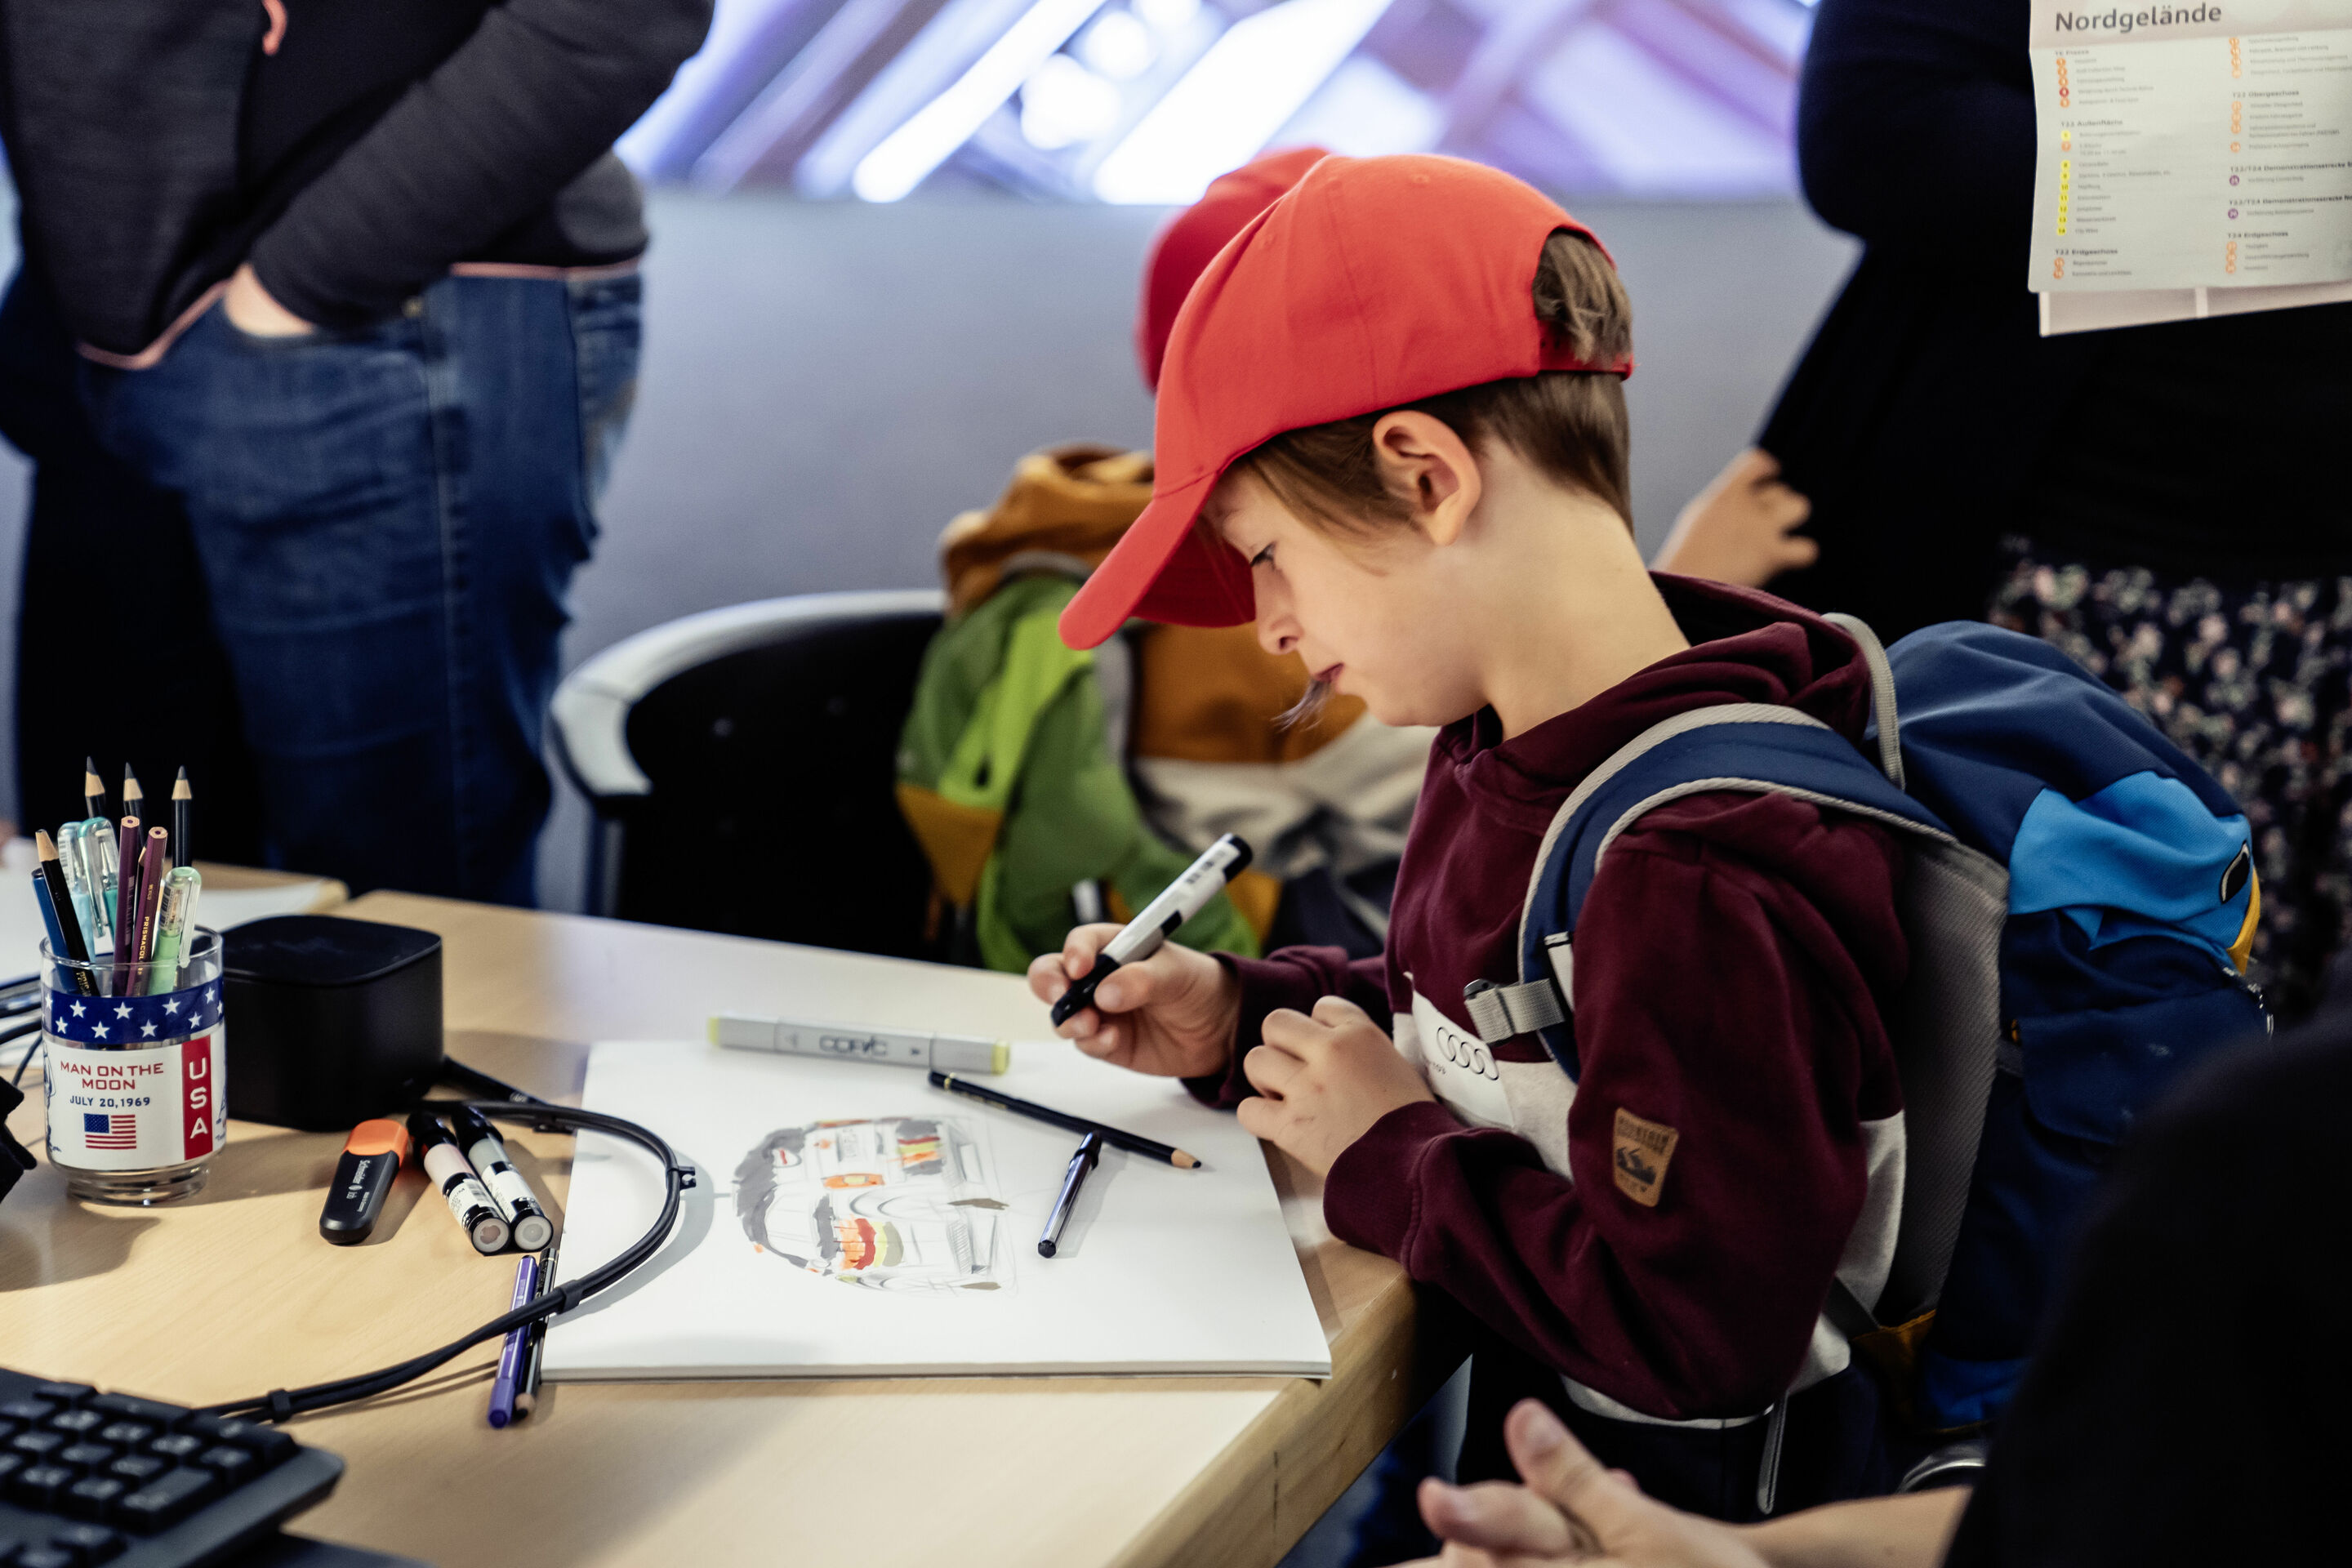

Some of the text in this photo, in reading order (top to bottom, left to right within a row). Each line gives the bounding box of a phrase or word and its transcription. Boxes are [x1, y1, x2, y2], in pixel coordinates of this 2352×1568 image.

[2056, 2, 2221, 33] Nordgelände
[138, 915, 149, 961] PRISMACOL
[60, 1060, 164, 1077] MAN ON THE
[82, 1079, 136, 1090] MOON
[69, 1095, 93, 1107] JULY
[189, 1057, 208, 1139] USA
